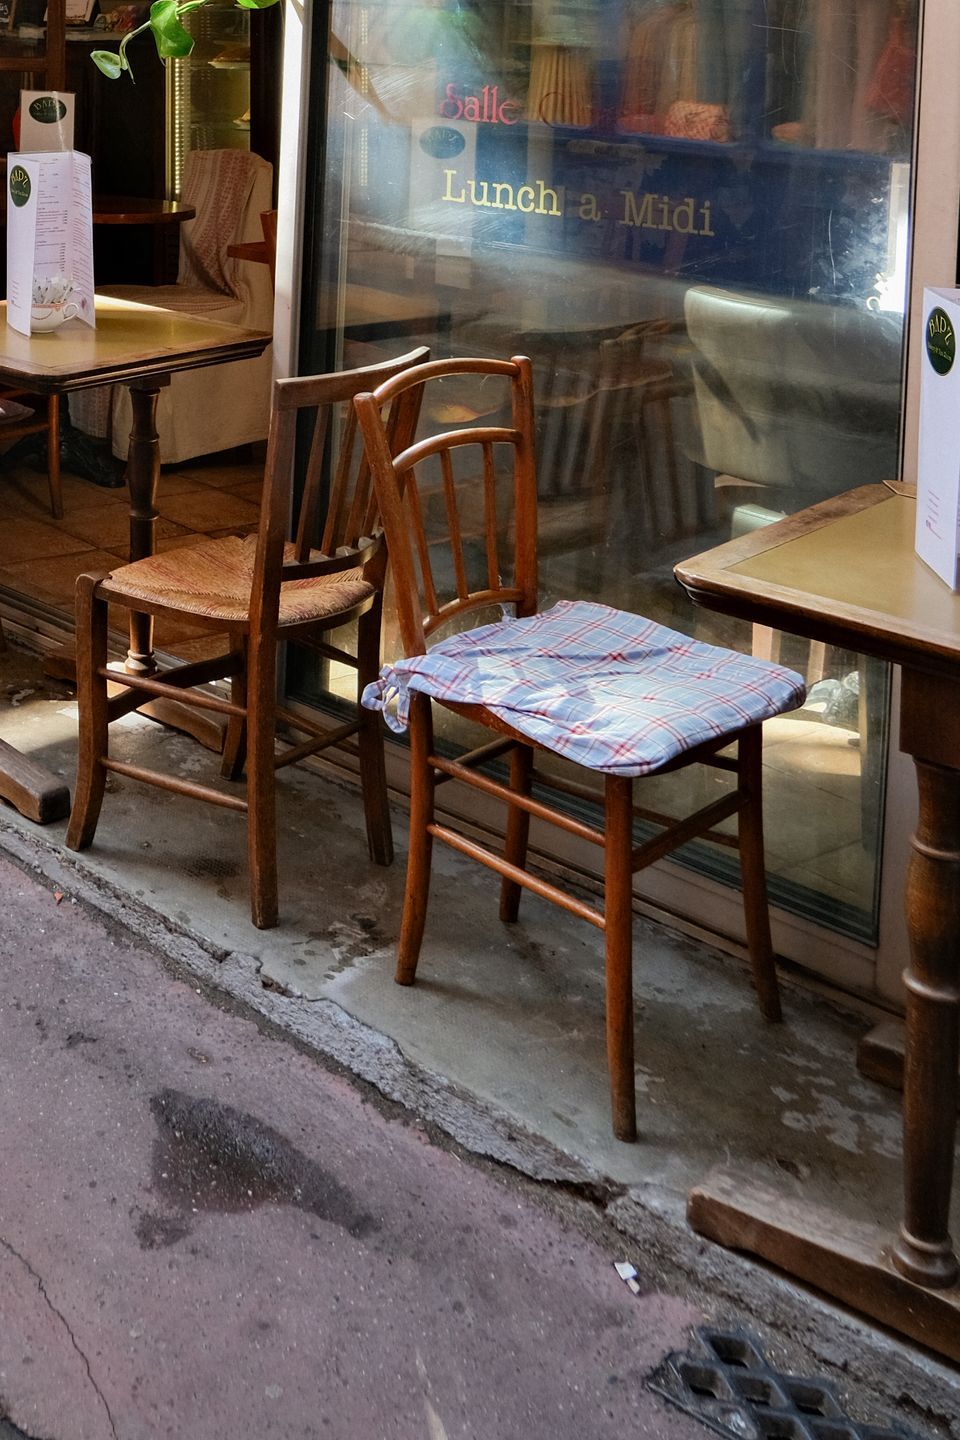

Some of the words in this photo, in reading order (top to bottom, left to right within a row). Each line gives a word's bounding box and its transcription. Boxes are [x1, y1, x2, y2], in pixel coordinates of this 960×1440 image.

[440, 82, 520, 125] Salle
[442, 169, 561, 217] Lunch
[618, 191, 716, 238] Midi
